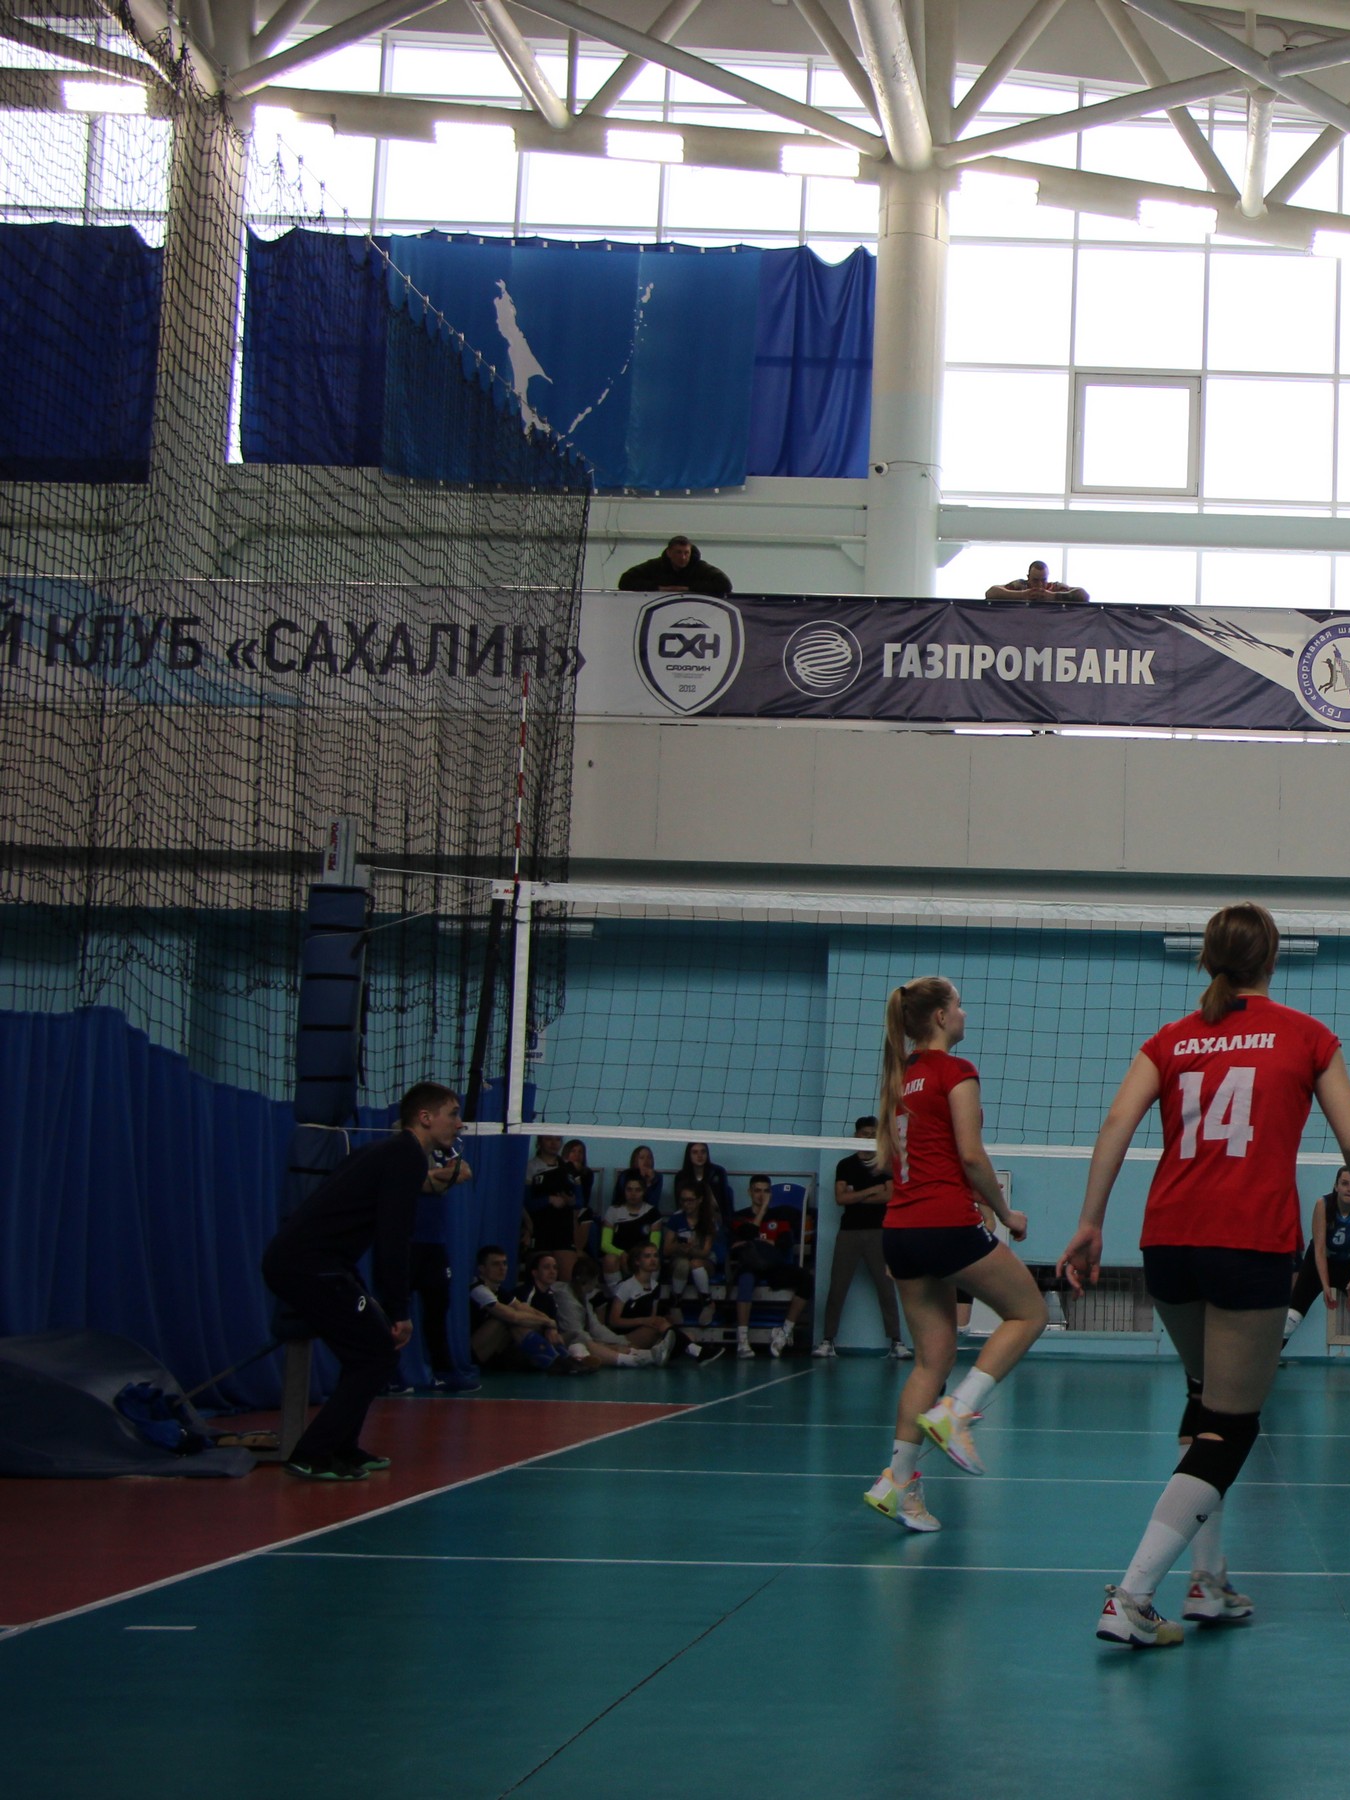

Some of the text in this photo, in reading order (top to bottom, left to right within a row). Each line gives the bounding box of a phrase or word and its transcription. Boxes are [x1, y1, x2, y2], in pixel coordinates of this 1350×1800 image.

[46, 612, 203, 670] КЛУБ
[226, 618, 586, 679] «САХАЛИН»
[666, 664, 711, 672] САХАЛИН
[882, 641, 1155, 686] ГАЗПРОМБАНК
[679, 684, 696, 693] 2012
[1319, 704, 1342, 719] ГБУ
[1173, 1033, 1276, 1056] САХАЛИН
[1178, 1066, 1257, 1160] 14
[1332, 1227, 1347, 1246] 5
